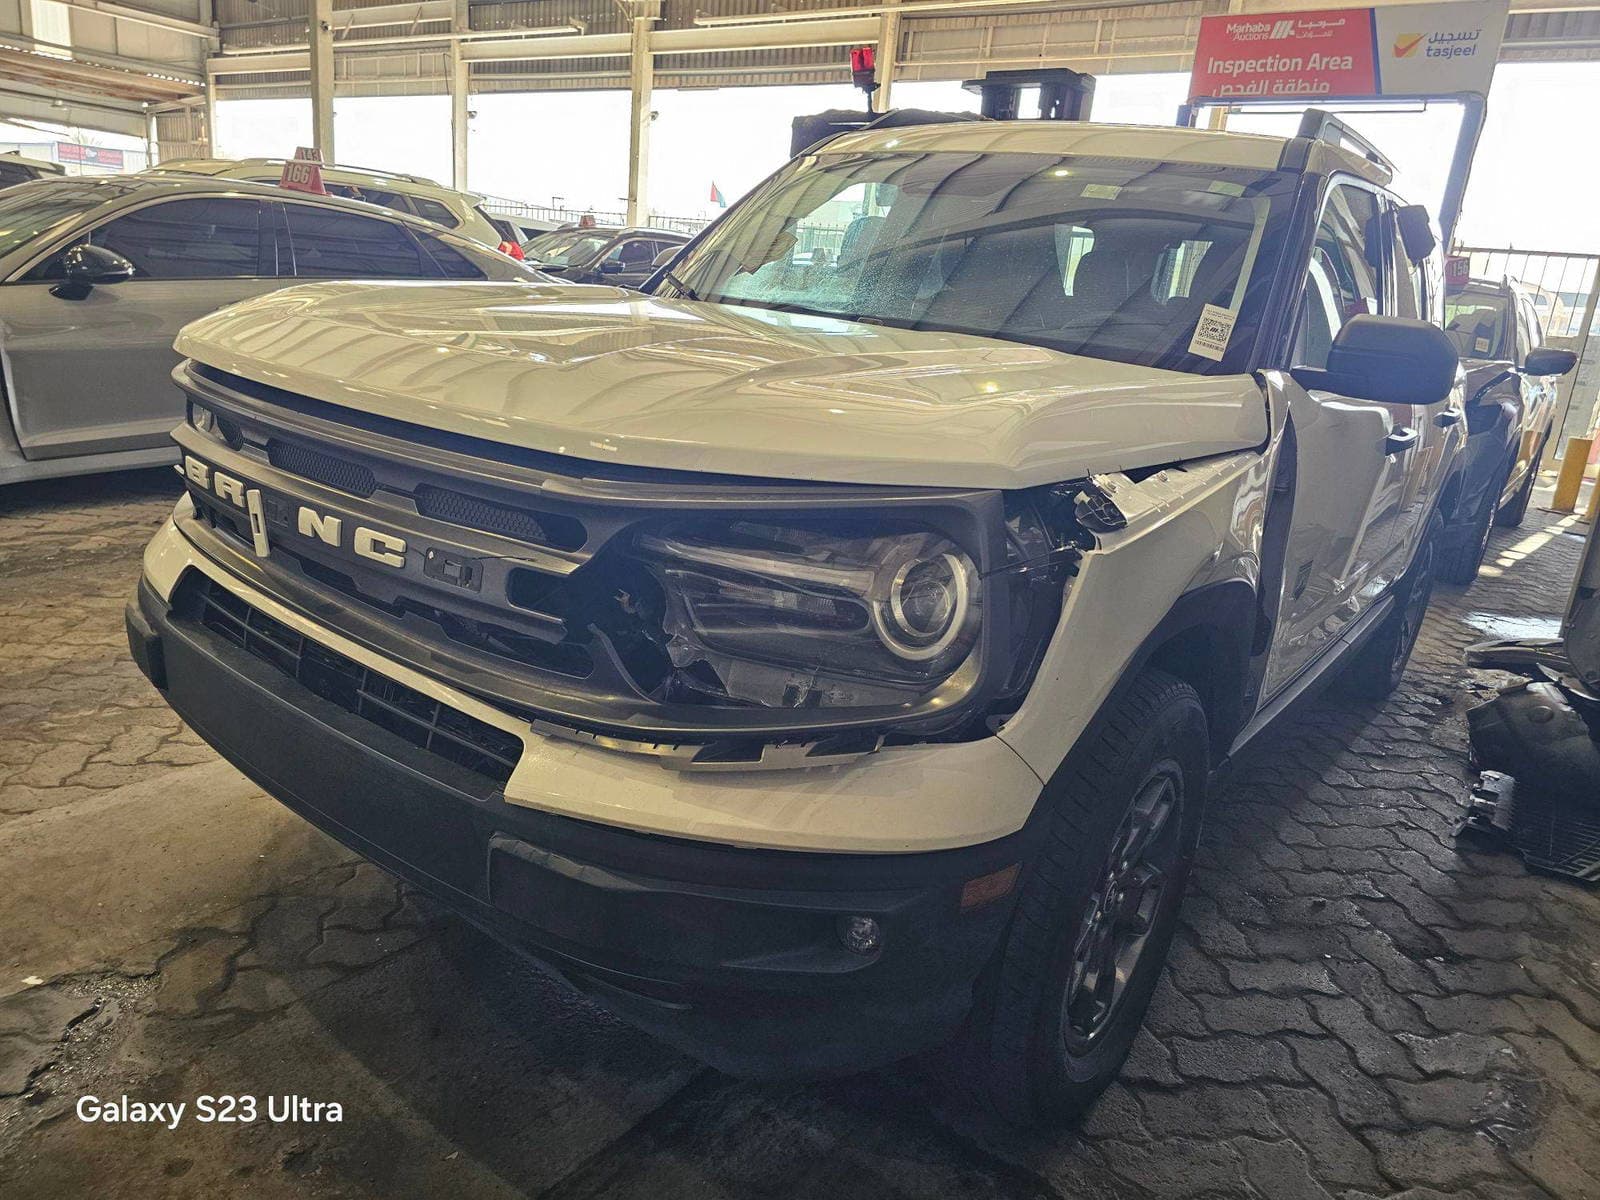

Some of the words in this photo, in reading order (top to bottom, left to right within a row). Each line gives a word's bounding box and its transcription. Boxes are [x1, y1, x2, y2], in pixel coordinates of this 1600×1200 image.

[1226, 23, 1270, 34] Marhaba
[1232, 32, 1270, 41] Auctions
[1428, 29, 1482, 45] تسجيل
[1425, 44, 1477, 60] tasjeel
[1207, 54, 1302, 77] Inspection
[1306, 52, 1353, 71] Area
[1272, 78, 1330, 95] منطقة
[287, 163, 310, 184] 166
